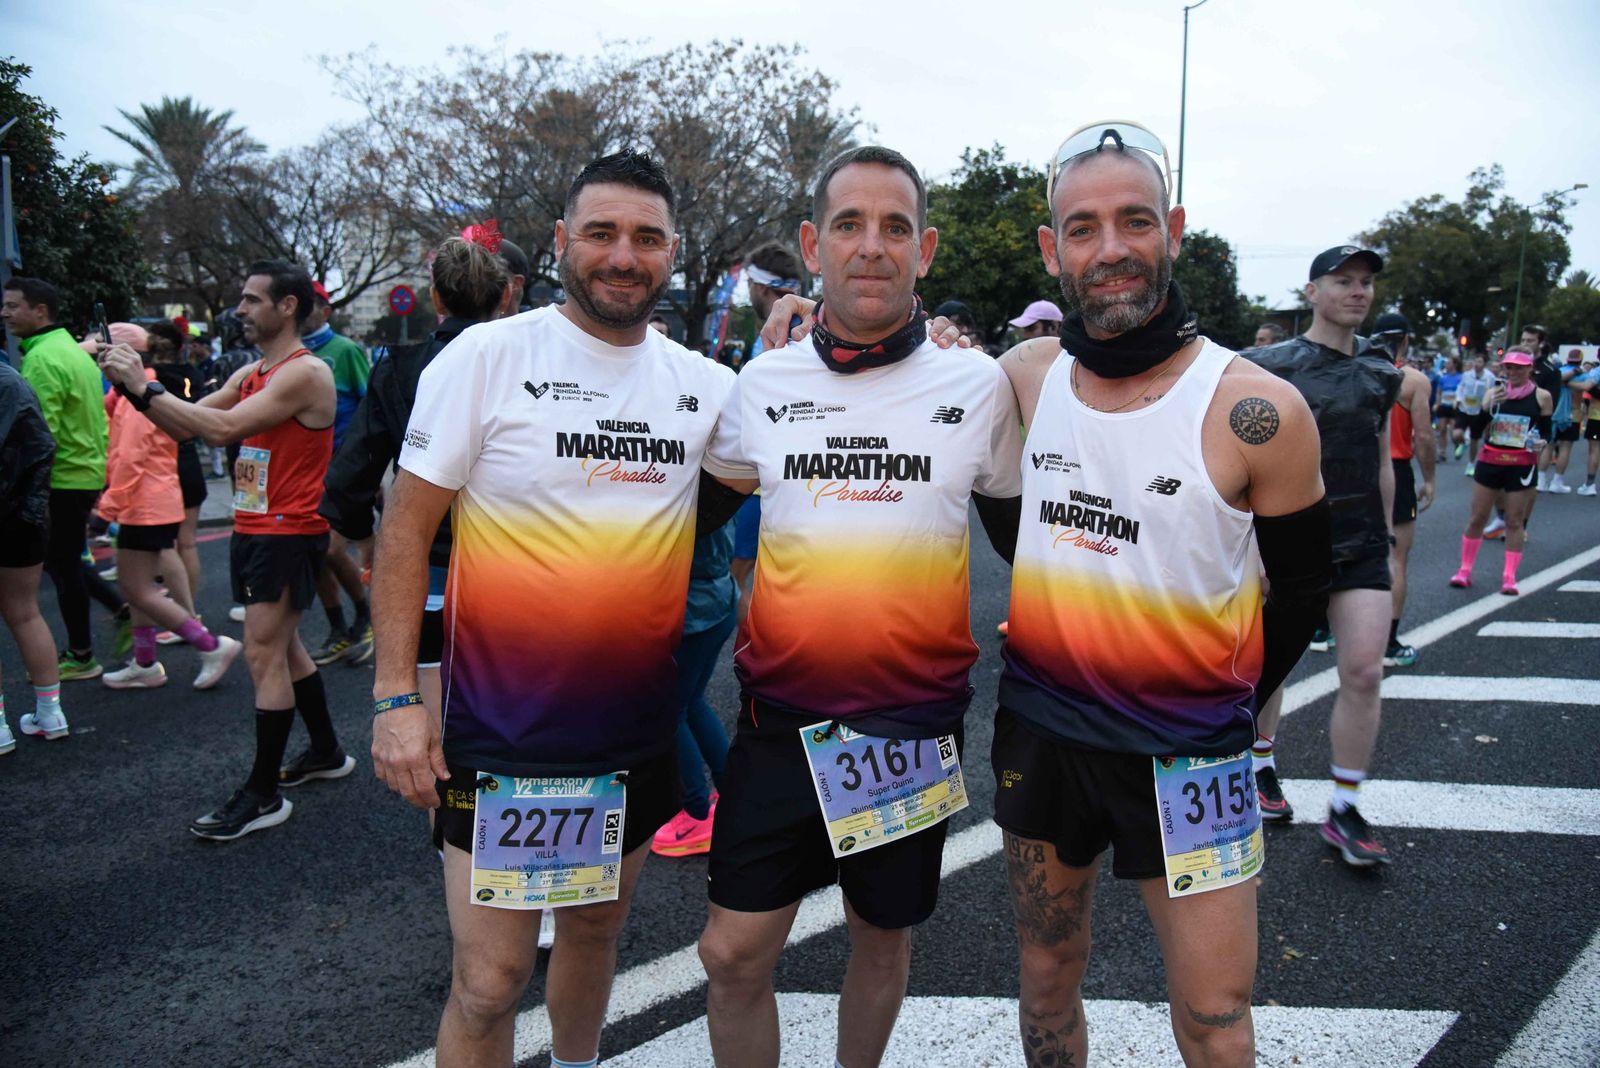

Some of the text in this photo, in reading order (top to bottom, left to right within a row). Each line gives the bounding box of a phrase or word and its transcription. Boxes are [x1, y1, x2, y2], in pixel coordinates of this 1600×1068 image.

[582, 390, 610, 398] ALFONSO
[790, 401, 814, 409] VALENCIA
[596, 420, 650, 434] VALENCIA
[556, 432, 684, 465] MARATHON
[826, 436, 888, 450] VALENCIA
[582, 454, 666, 487] Paradise
[784, 454, 931, 482] MARATHON
[807, 474, 904, 508] Paradise
[1070, 490, 1112, 510] VALENCIA
[1040, 500, 1140, 544] MARATHON
[1050, 521, 1118, 556] Paradise
[836, 739, 922, 791] 3167
[542, 784, 582, 794] sevilla
[868, 776, 914, 798] Super Quino
[1182, 768, 1253, 825] 3155
[851, 804, 873, 814] Quino
[498, 808, 594, 848] 2277
[884, 824, 904, 836] HOKA
[1192, 841, 1214, 850] Javito
[535, 850, 558, 859] VILLA
[562, 861, 586, 870] puente
[1221, 868, 1240, 879] HOKA
[524, 894, 546, 902] HOKA
